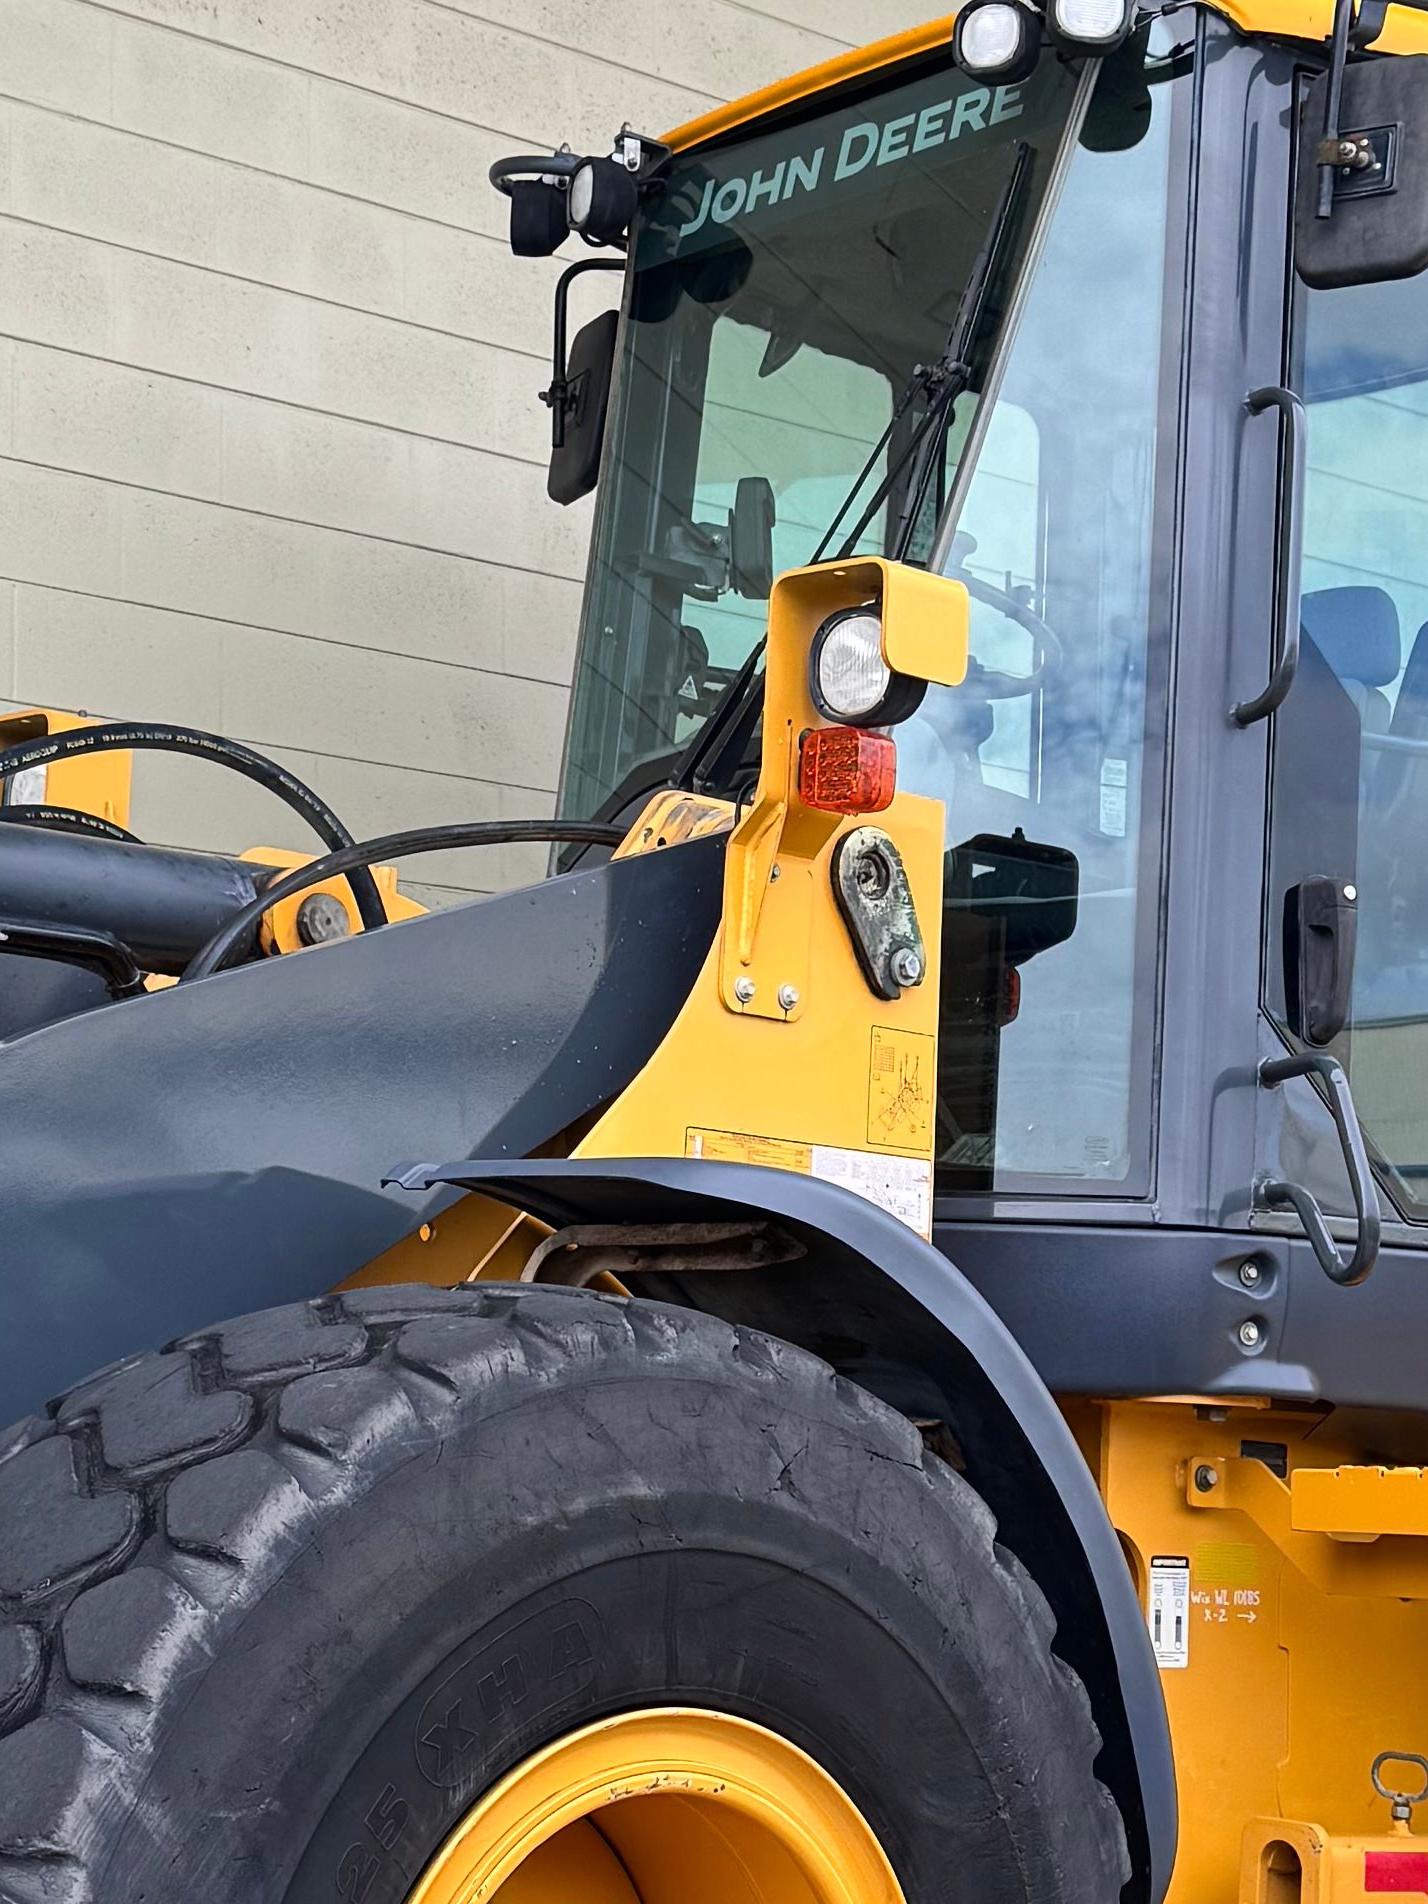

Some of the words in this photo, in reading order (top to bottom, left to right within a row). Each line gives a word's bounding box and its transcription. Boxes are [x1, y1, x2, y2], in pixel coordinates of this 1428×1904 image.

[679, 147, 824, 238] JOHN
[833, 83, 1025, 182] DEERE
[421, 1620, 595, 1778] XHA
